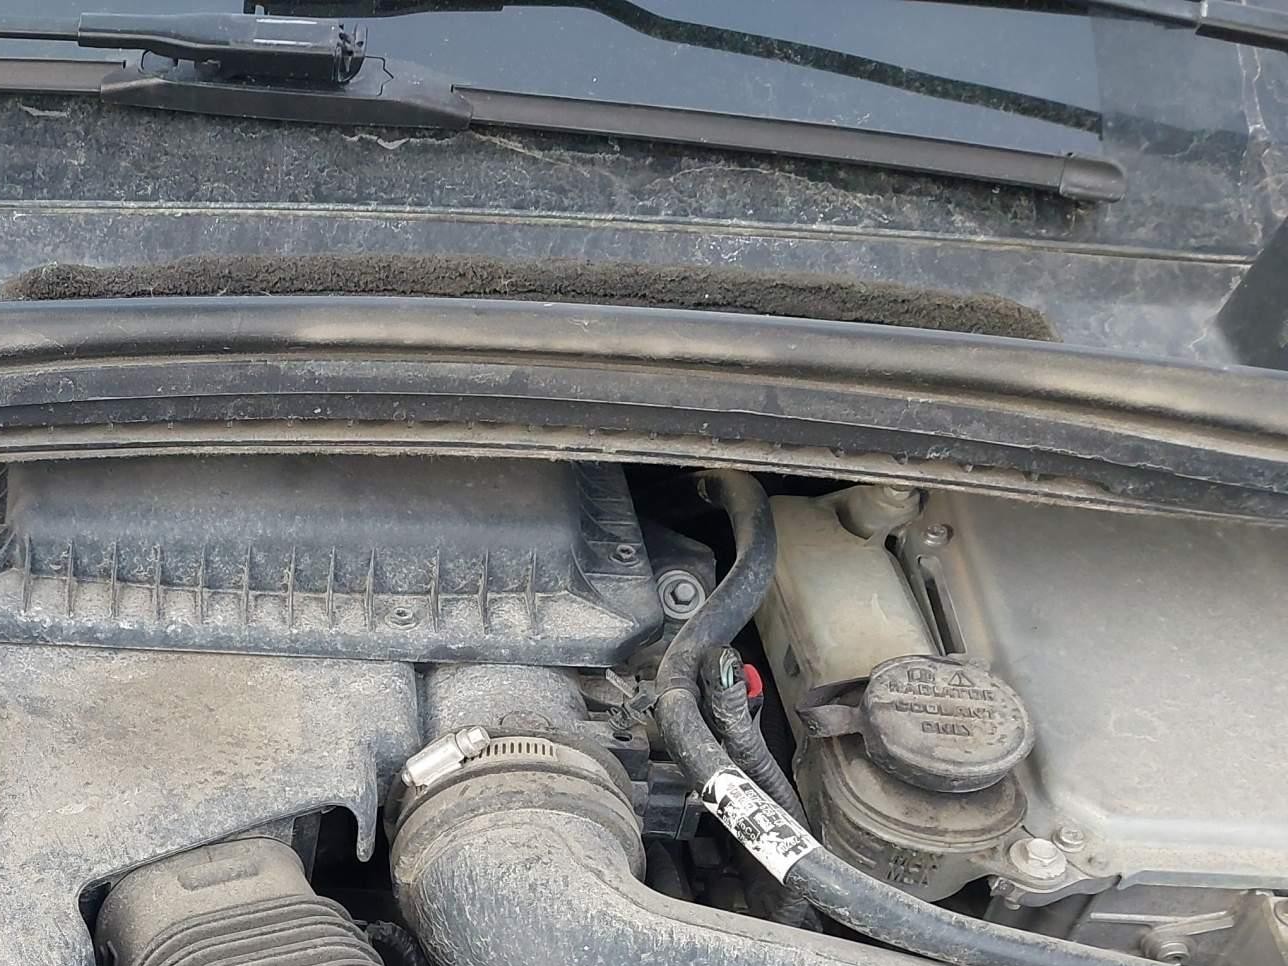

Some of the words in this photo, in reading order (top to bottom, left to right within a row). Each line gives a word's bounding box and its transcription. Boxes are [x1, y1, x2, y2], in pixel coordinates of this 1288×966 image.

[887, 680, 995, 702] RADIATOR
[895, 700, 993, 720] COOLANT
[921, 720, 972, 737] ONLY
